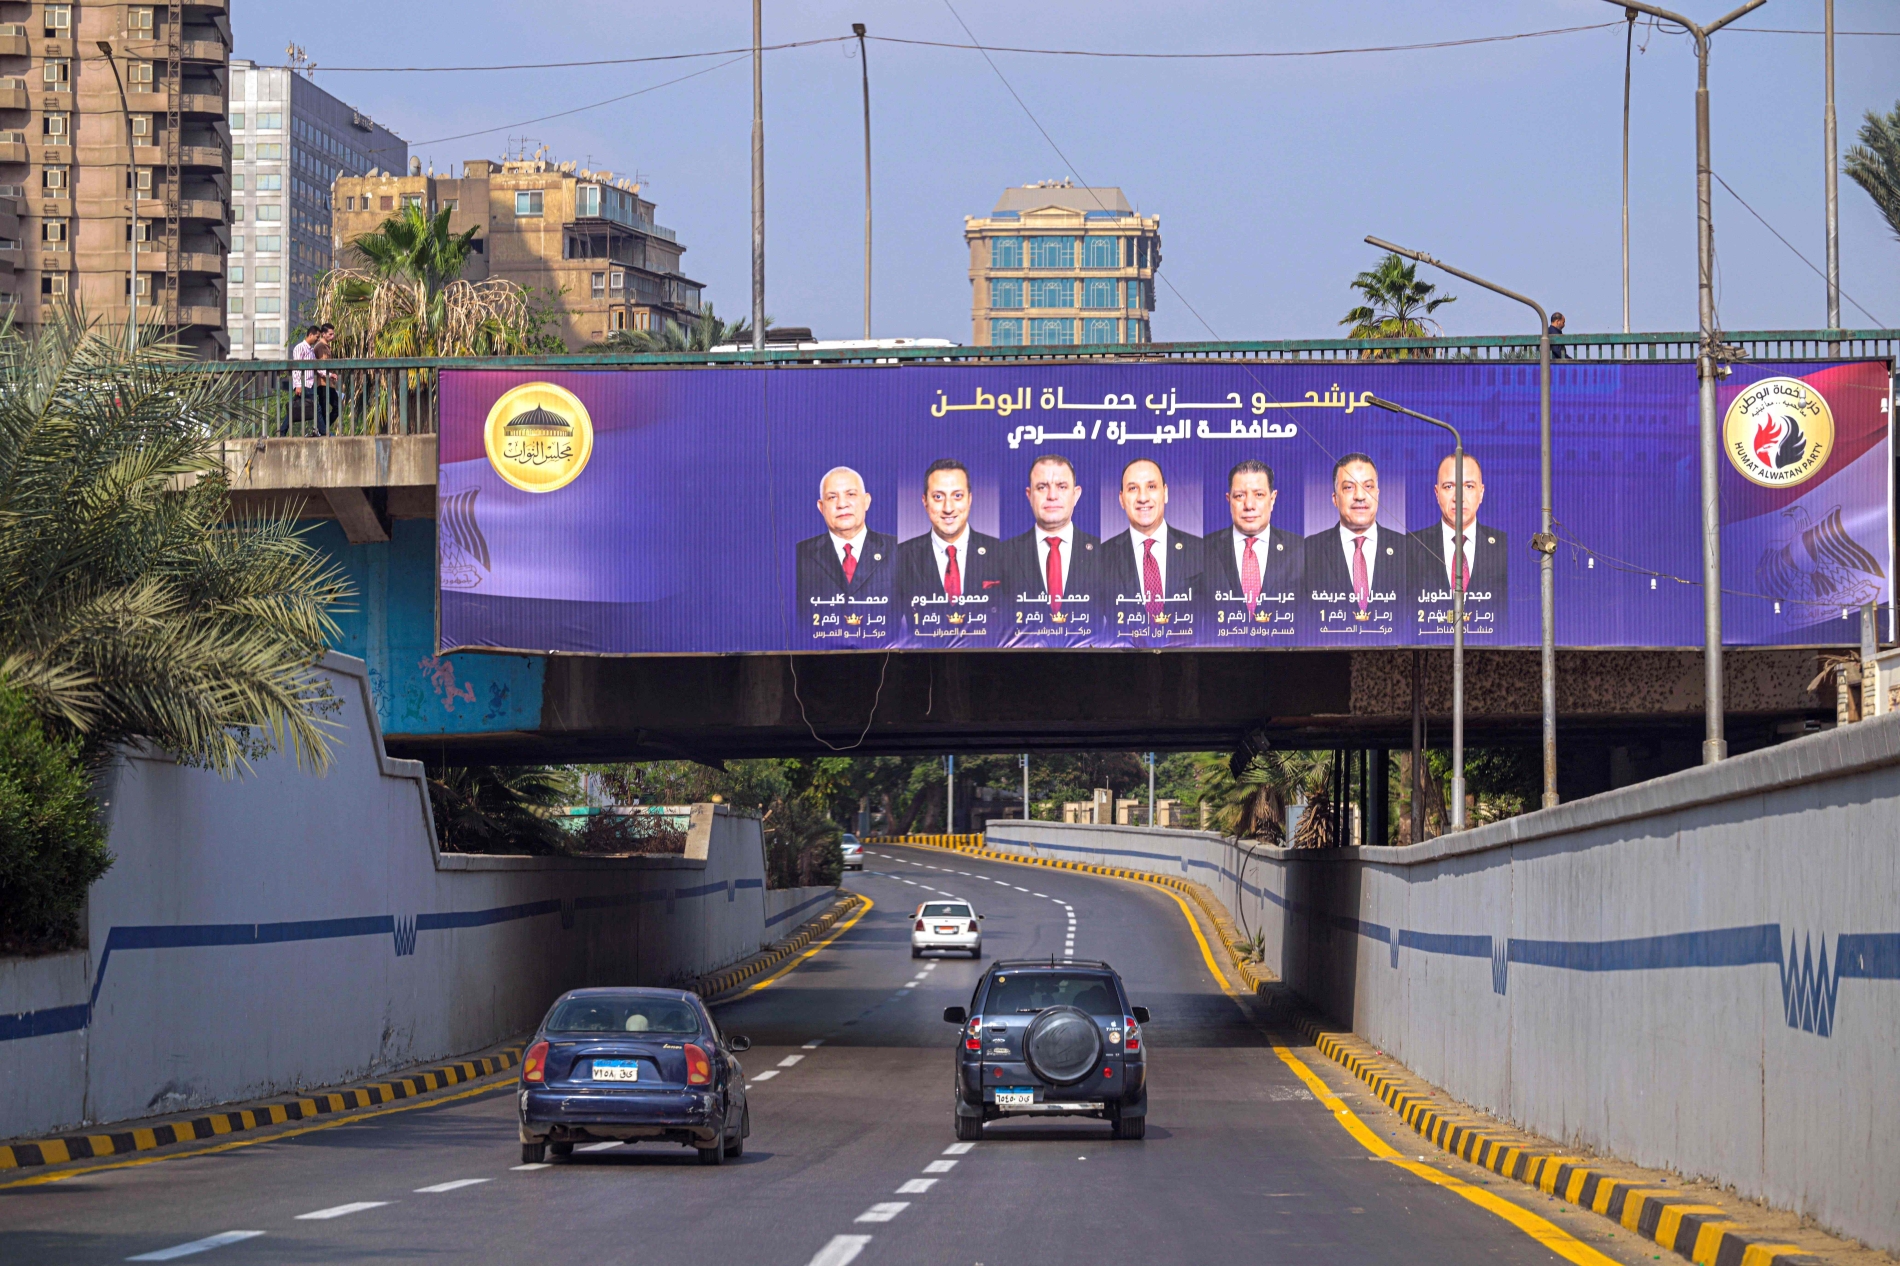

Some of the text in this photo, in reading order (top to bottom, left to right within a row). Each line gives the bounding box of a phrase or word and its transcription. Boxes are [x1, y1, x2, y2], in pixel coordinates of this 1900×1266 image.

[931, 383, 1374, 417] مرشحو حزب حماة الوطن
[1738, 387, 1770, 415] الوطن
[1007, 419, 1298, 449] محافظة الجيزة / فردي
[1734, 441, 1823, 480] HUMAT ALWATAN PARTY
[810, 593, 889, 606] محمد كليب
[951, 594, 989, 605] محمود
[1016, 591, 1090, 605] محمد رشاد
[1154, 587, 1192, 603] أحمد
[1215, 589, 1295, 606] عربي زيادة
[1312, 590, 1347, 603] عريضة
[1367, 589, 1397, 603] فيصل
[813, 613, 886, 625] رمز رقم 2
[913, 612, 987, 625] رمز رقم 1
[1016, 611, 1090, 624] رمز رقم 2
[1117, 611, 1194, 625] رمز رقم 2
[1217, 610, 1294, 624] رمز رقم 3
[1319, 610, 1393, 622] رمز رقم 1
[1417, 609, 1425, 622] 2
[1474, 610, 1494, 622] رمز
[812, 627, 886, 639] مركز أبو النمرس
[914, 627, 987, 638] قسم العمرانية
[1014, 626, 1092, 637] مركز البدرشين
[1166, 627, 1193, 638] قسم
[1217, 626, 1248, 636] الدكرور
[1271, 627, 1295, 637] قسم
[1359, 625, 1393, 635] مركز
